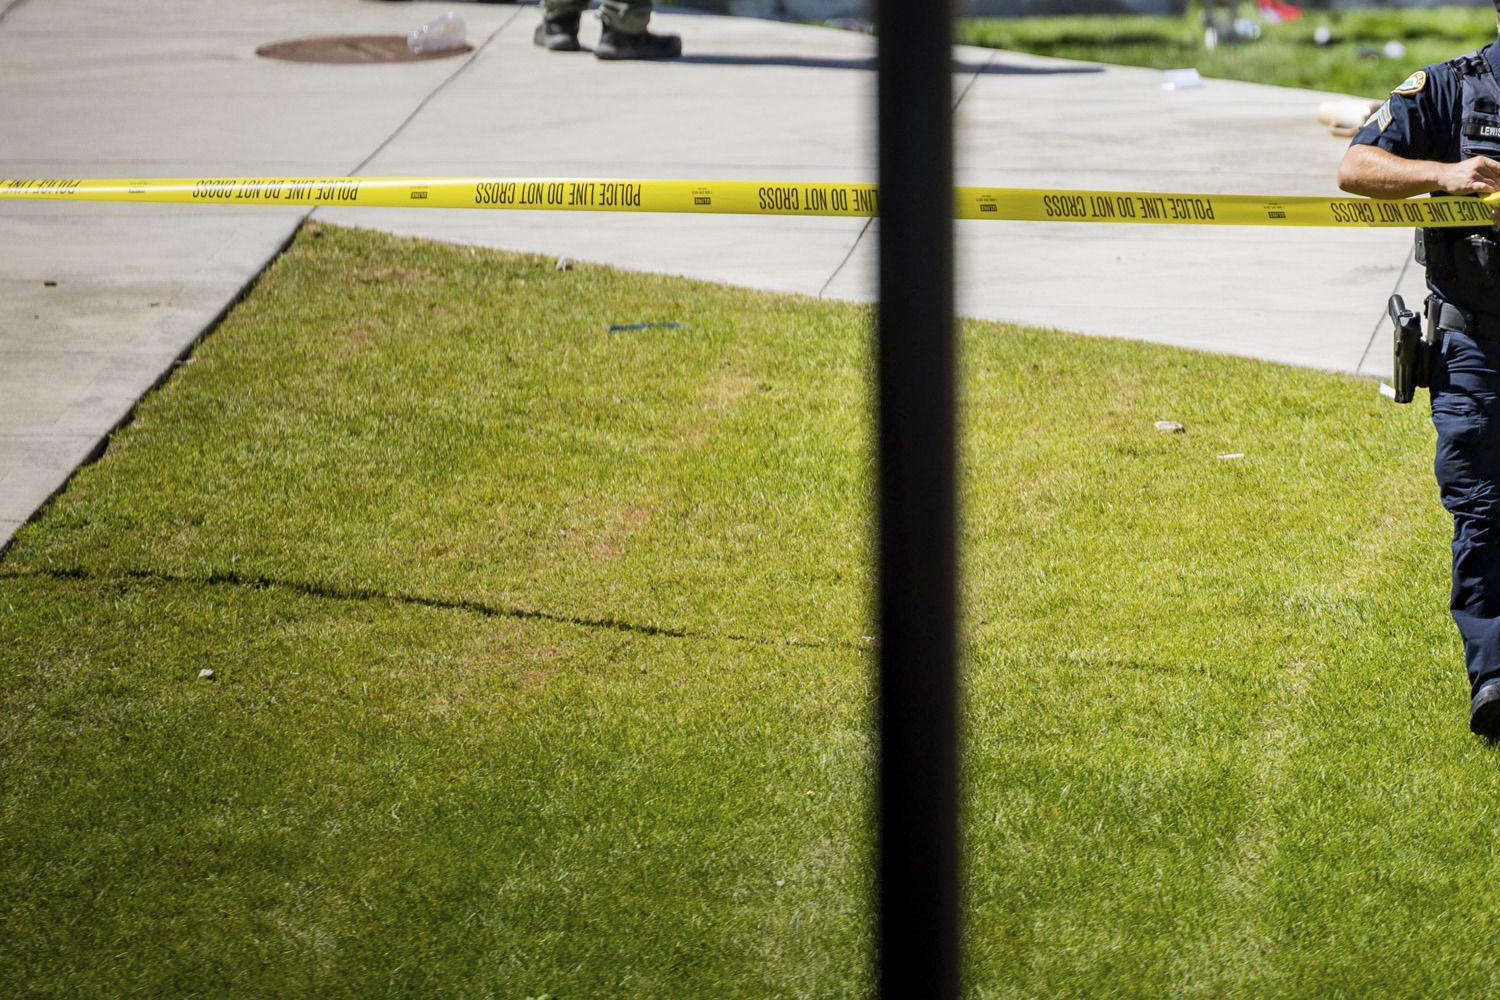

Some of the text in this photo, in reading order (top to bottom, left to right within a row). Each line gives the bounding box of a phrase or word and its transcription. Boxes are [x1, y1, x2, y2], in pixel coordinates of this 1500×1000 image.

[192, 180, 360, 201] POLICE LINE DO NOT CROSS
[475, 182, 641, 206] POLICE LINE DO NOT CROSS
[758, 187, 799, 210] CROSS
[803, 188, 827, 211] NOT
[831, 188, 848, 211] DO
[1043, 195, 1215, 220] POLICE LINE DO NOT CROSS
[1330, 202, 1375, 223] CROSS
[1378, 202, 1405, 223] NOT
[1403, 202, 1424, 222] DO
[1423, 201, 1456, 222] LINE
